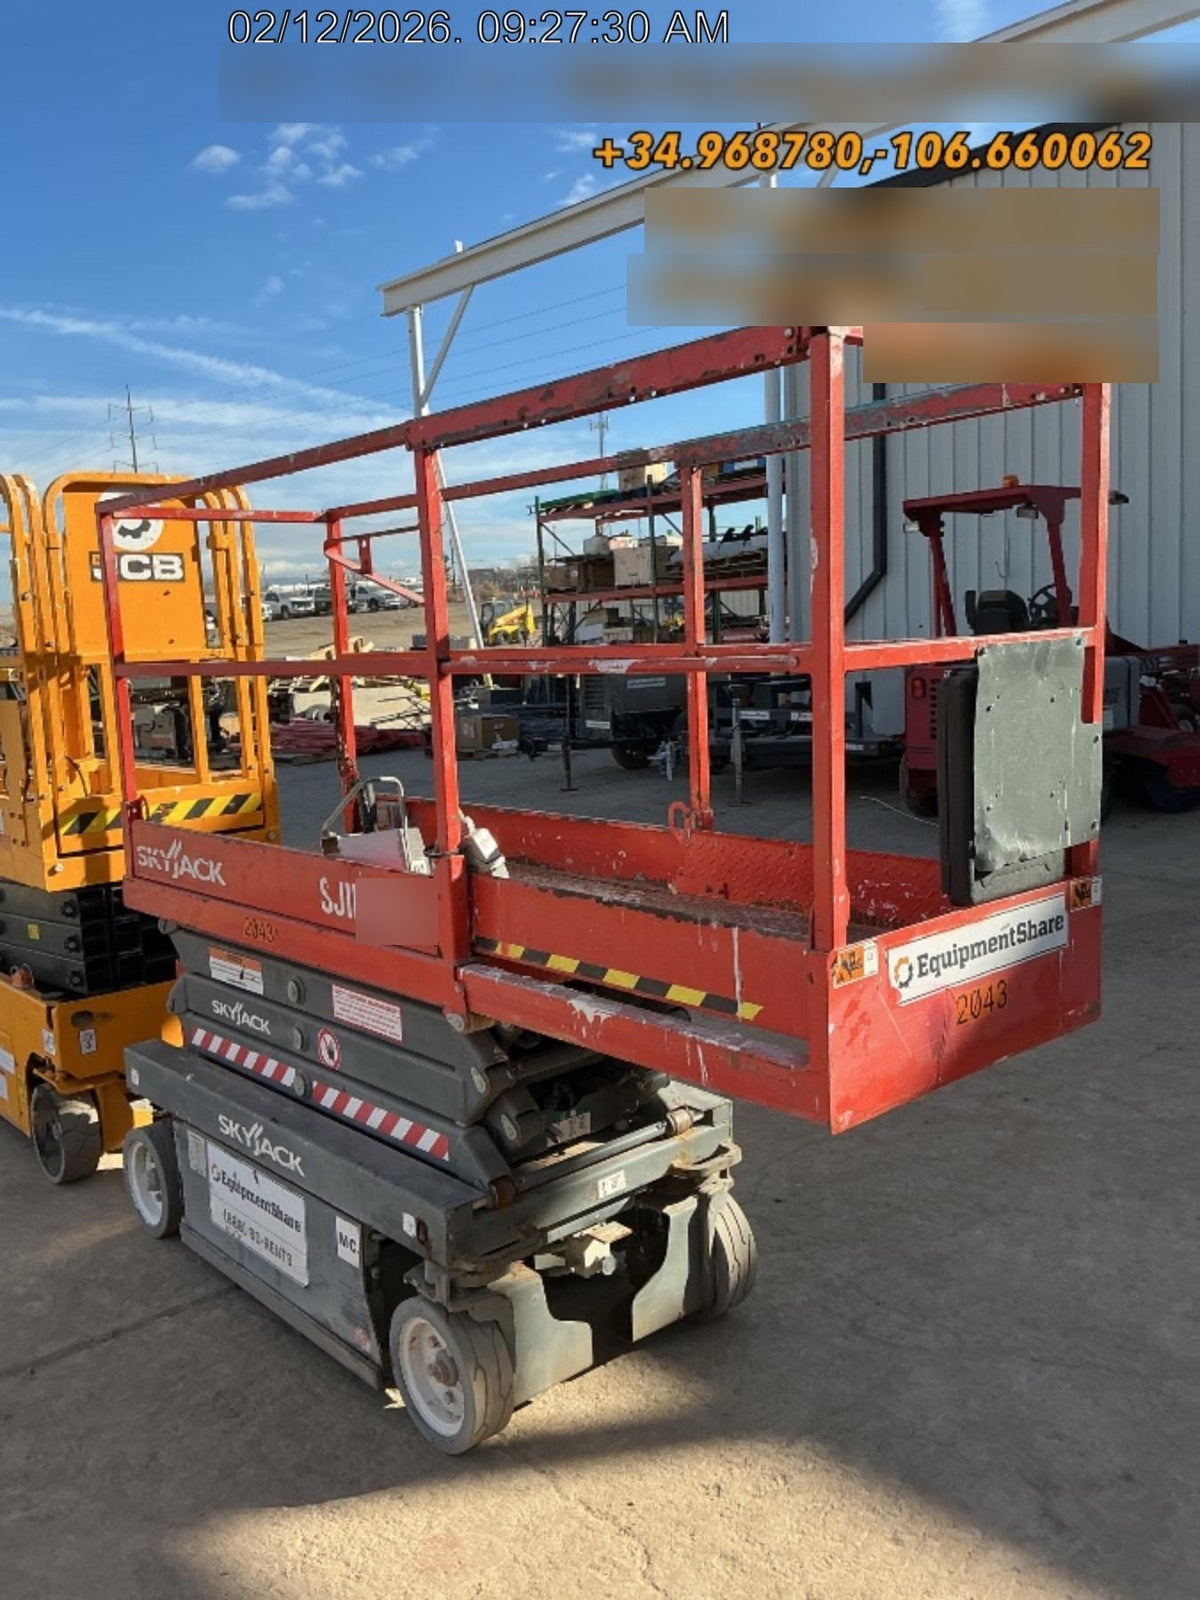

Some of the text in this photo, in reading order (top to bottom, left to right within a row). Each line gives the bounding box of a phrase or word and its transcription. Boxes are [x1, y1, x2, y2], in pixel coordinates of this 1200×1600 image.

[136, 838, 226, 886] SKYJACK
[917, 914, 1064, 978] EquipmentShare
[211, 1000, 271, 1035] SKYJACK
[957, 979, 1007, 1026] 2043
[217, 1114, 305, 1178] SKYJACK
[221, 1170, 302, 1232] EquipmentShare
